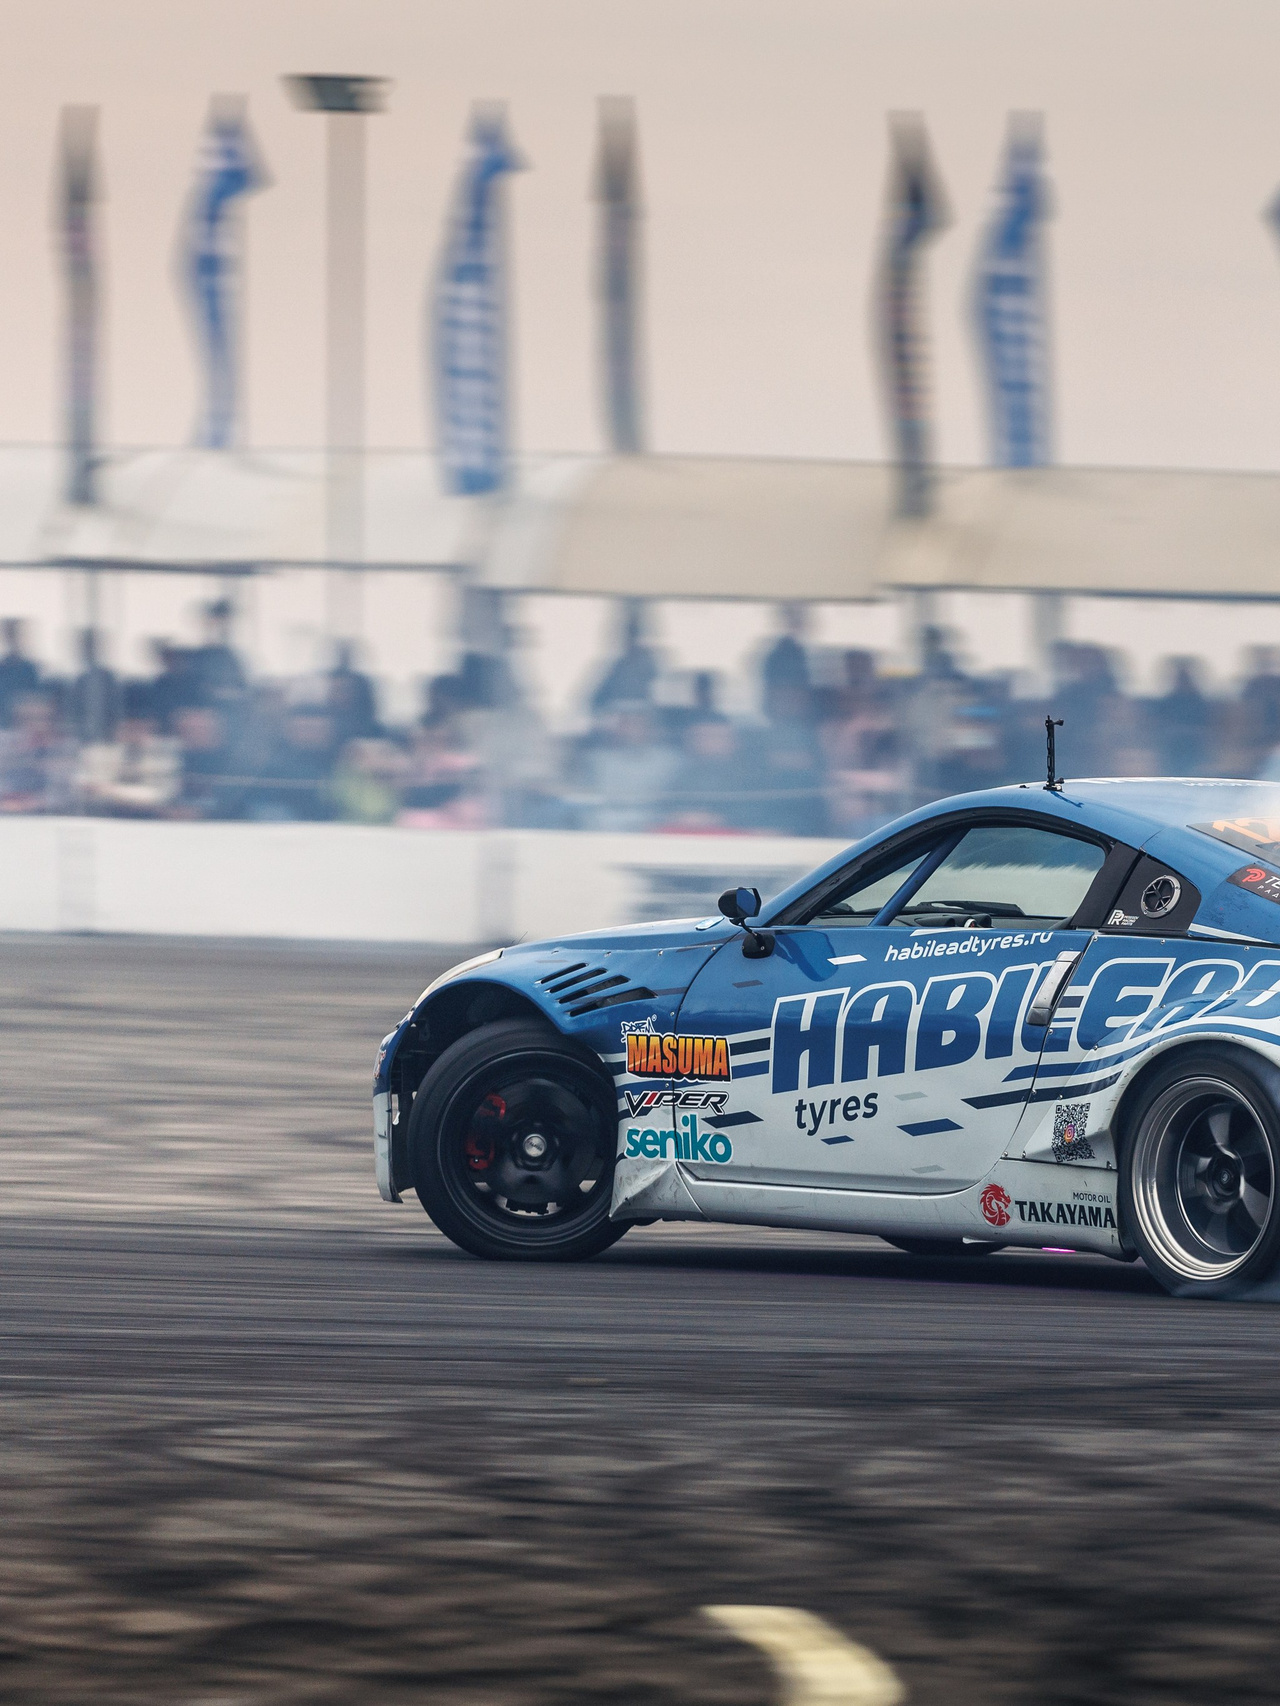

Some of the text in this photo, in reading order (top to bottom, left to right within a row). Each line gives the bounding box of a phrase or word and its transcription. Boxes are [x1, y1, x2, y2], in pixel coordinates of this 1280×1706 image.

[884, 932, 1053, 962] habileadtyres.ru
[626, 1034, 731, 1078] MASUMA
[625, 1090, 729, 1119] VIPER
[795, 1091, 879, 1136] tyres
[625, 1114, 733, 1163] seniko
[1073, 1191, 1111, 1204] MOTOR OIL
[1015, 1200, 1117, 1229] TAKAYAMA
